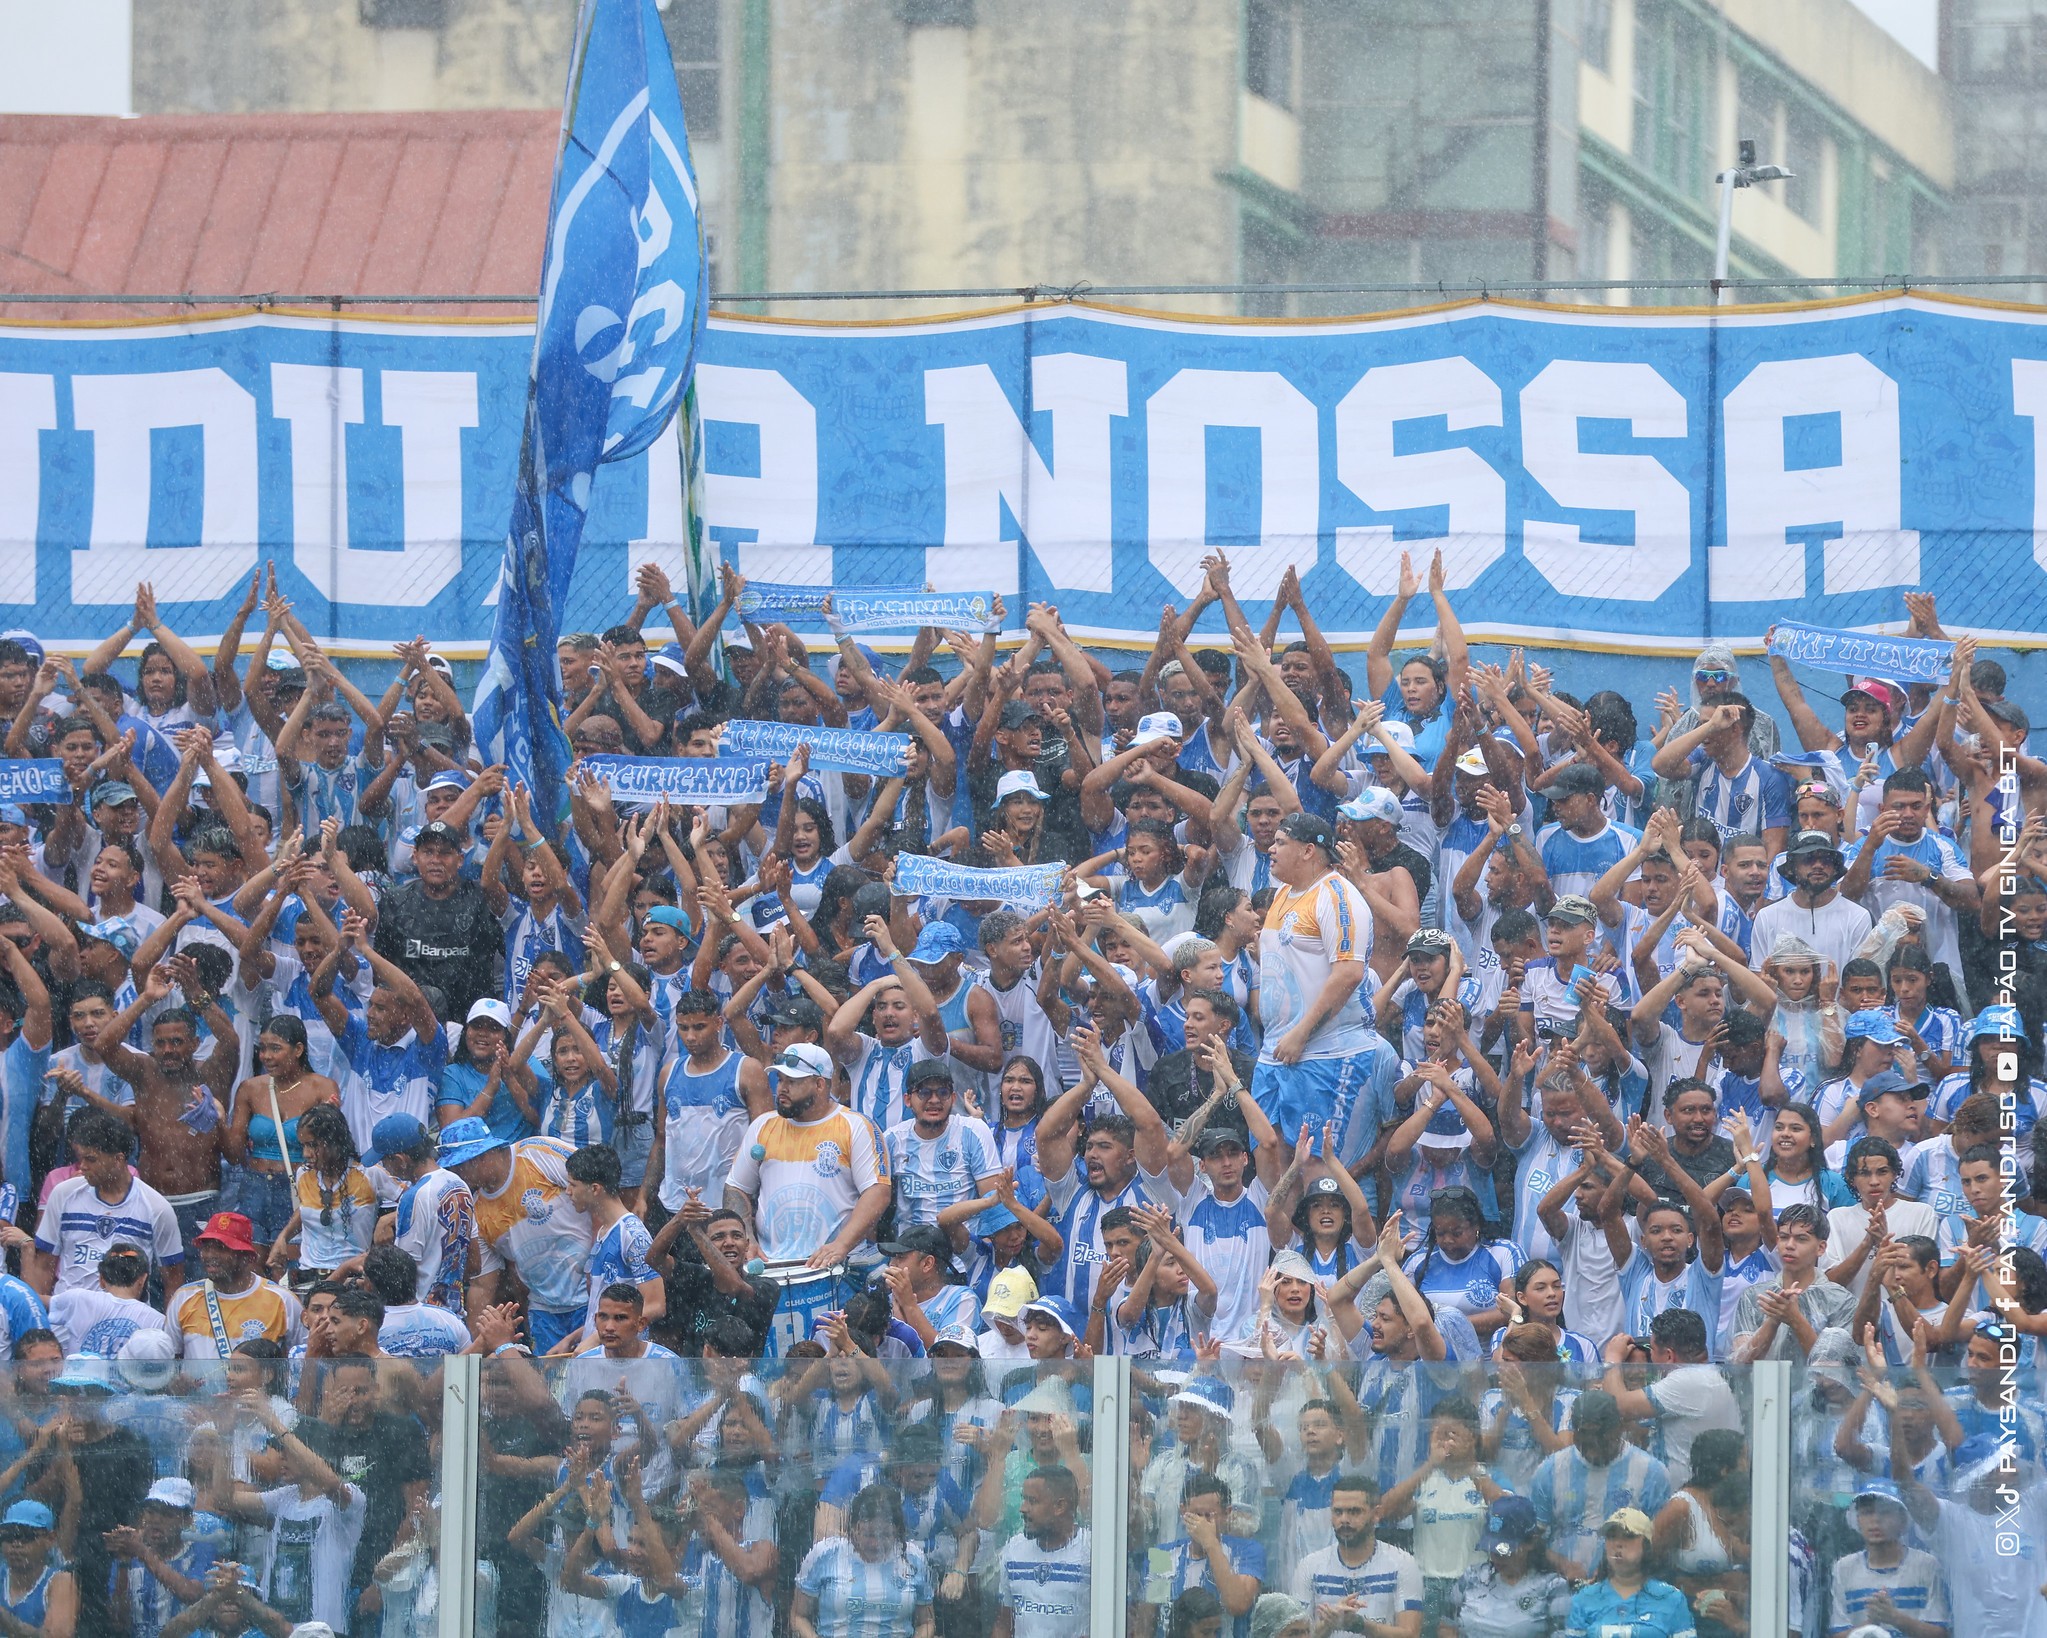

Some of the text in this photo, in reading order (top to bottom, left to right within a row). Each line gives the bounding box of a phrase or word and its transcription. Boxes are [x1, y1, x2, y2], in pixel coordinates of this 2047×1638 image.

[923, 352, 1921, 603] NOSSA
[866, 618, 917, 628] HOOLIGANS
[931, 617, 970, 627] AUGUSTO
[421, 944, 470, 958] Banpará
[1329, 1055, 1355, 1148] UXADOR
[784, 1297, 806, 1308] OLHA
